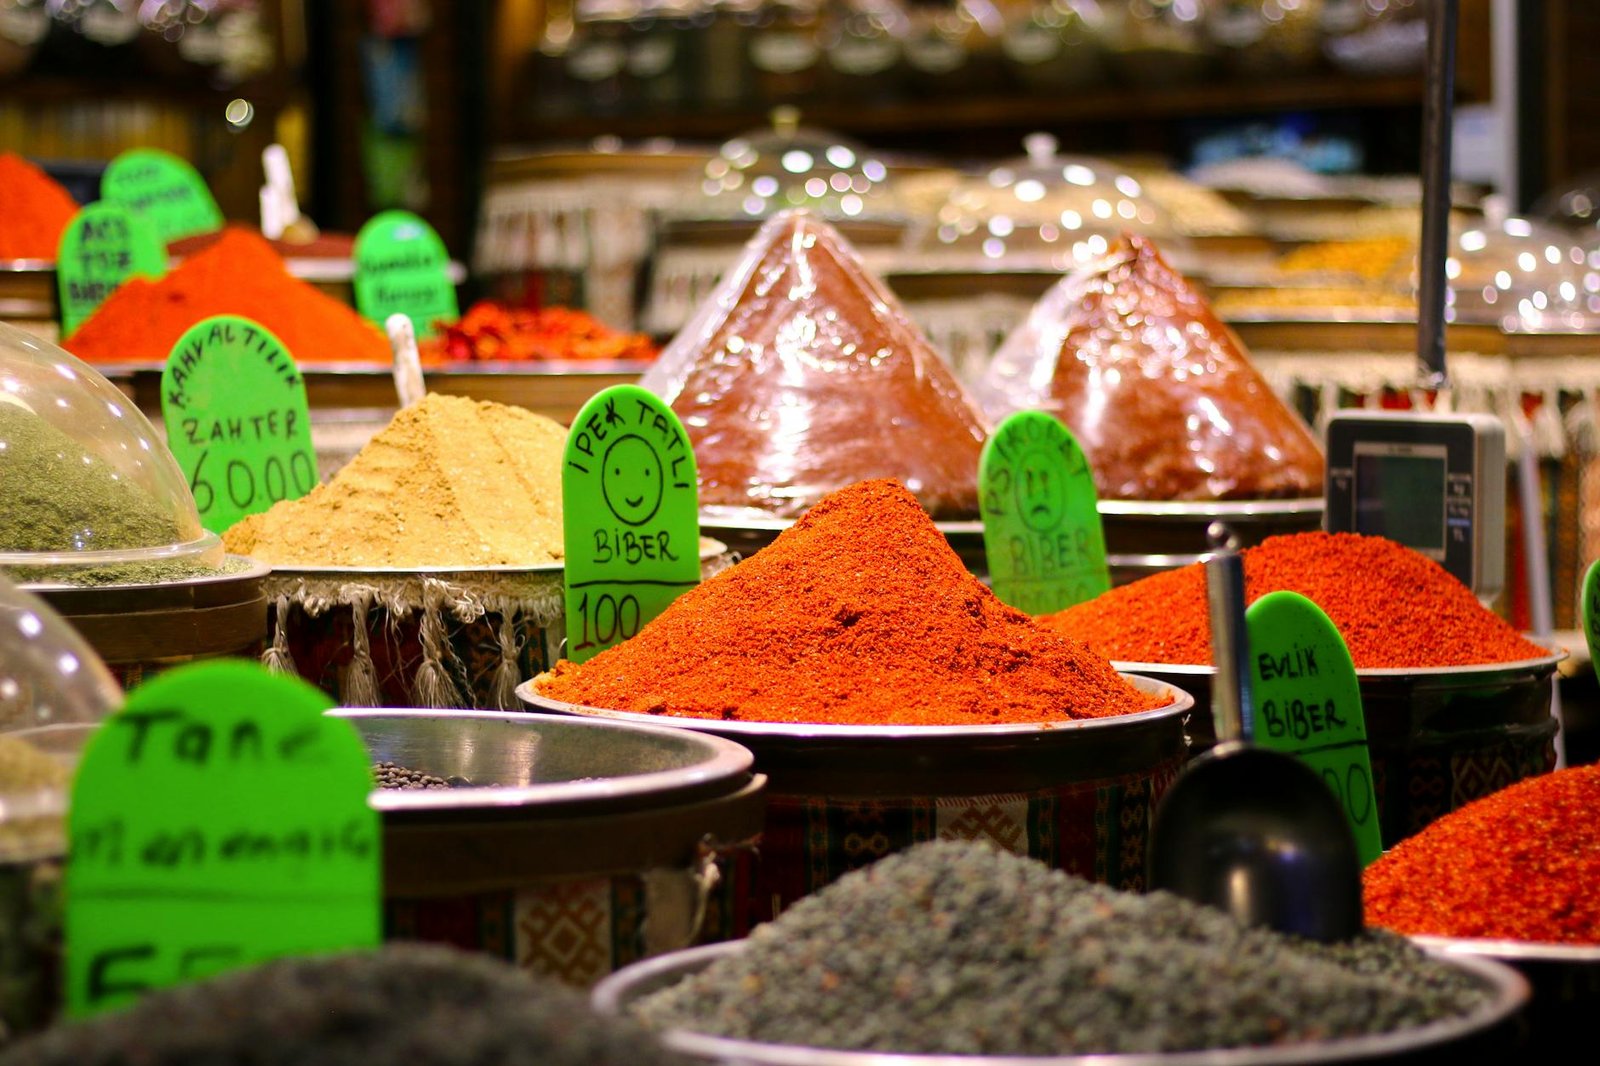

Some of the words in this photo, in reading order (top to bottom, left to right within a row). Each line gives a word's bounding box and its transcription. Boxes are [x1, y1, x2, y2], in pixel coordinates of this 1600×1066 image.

[182, 408, 298, 445] ZAHTER
[636, 398, 690, 489] TATLI
[573, 591, 641, 652] 100
